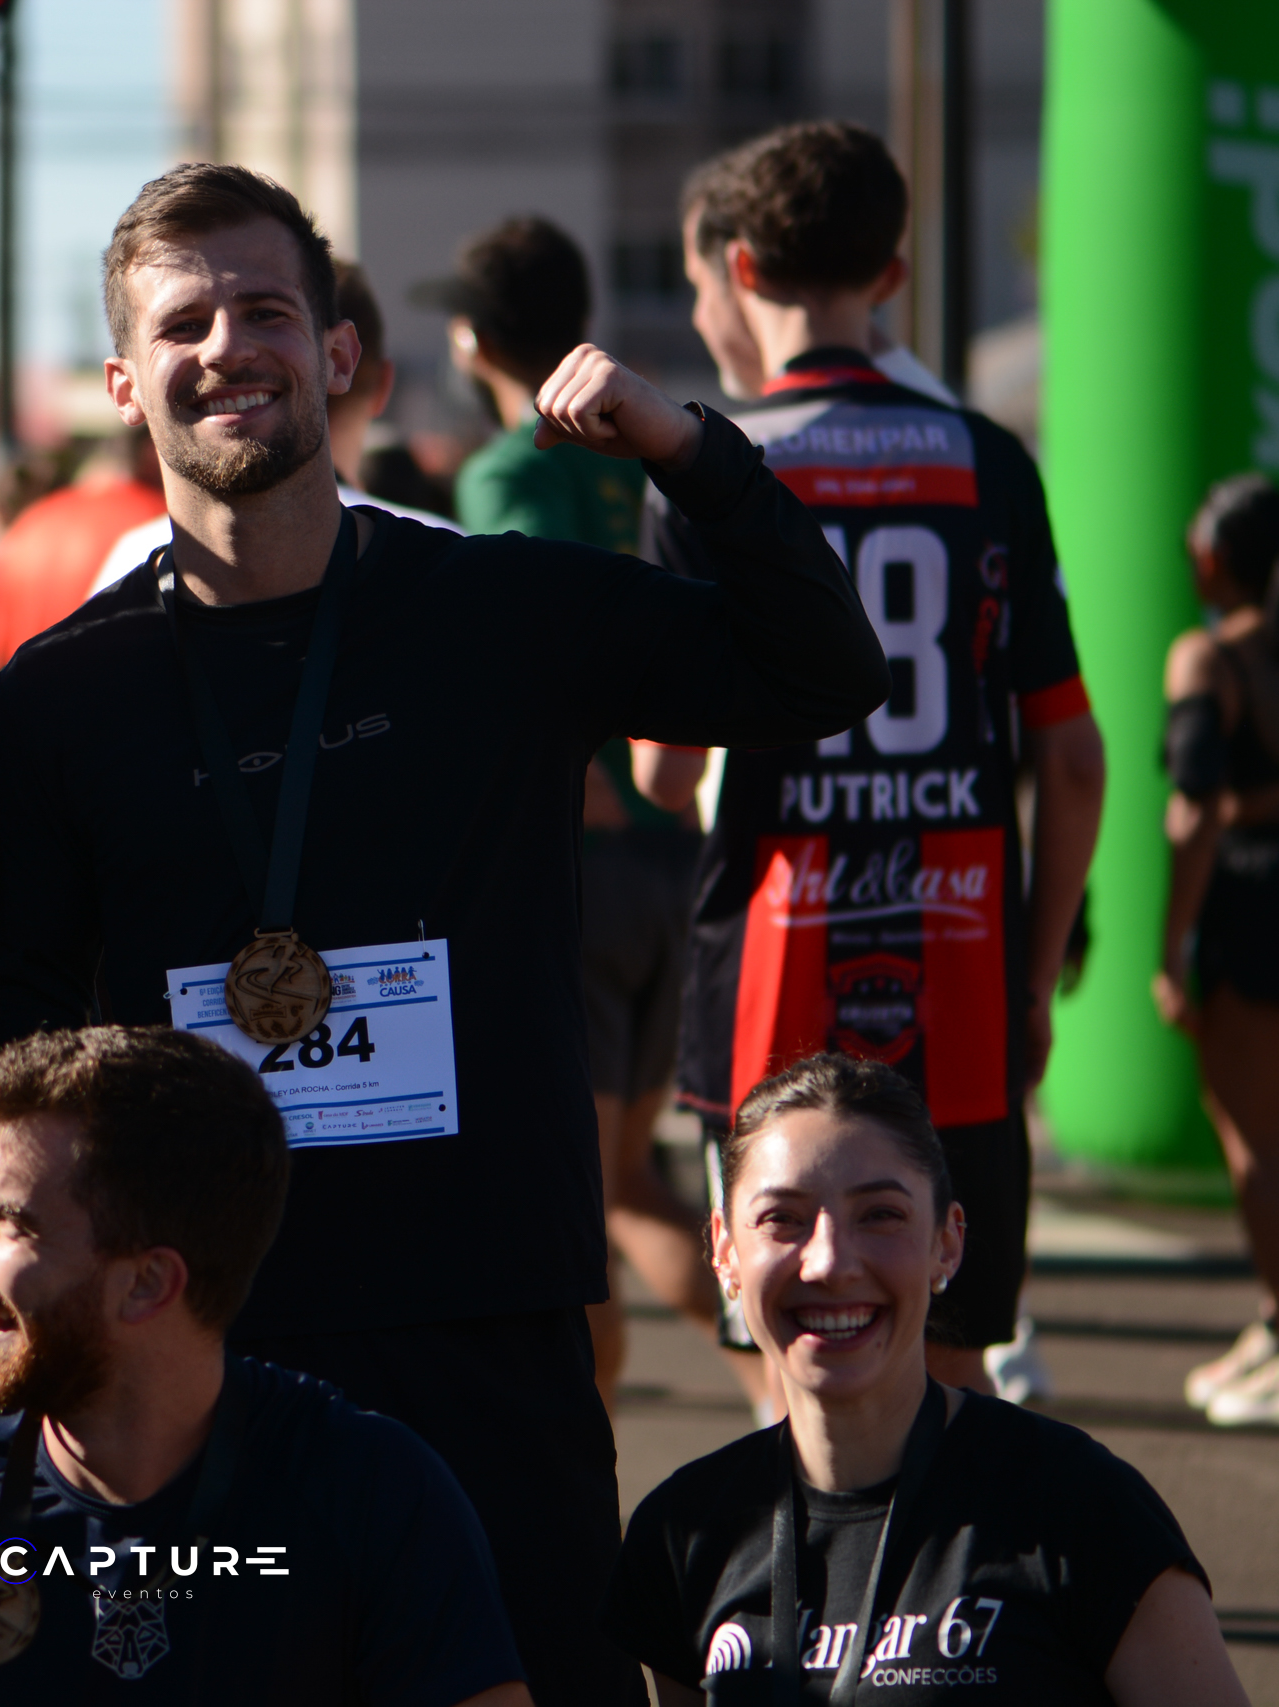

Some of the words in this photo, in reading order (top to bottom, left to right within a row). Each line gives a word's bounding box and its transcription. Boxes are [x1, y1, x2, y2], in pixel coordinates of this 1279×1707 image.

[779, 768, 982, 824] PUTRICK
[207, 984, 225, 995] EDIÇÃ
[379, 985, 417, 997] CAUSA
[289, 1087, 301, 1095] DA
[301, 1085, 329, 1093] ROCHA
[335, 1083, 360, 1091] Corrida
[288, 1113, 314, 1121] CRESOL
[937, 1595, 1004, 1660] 67
[872, 1664, 998, 1687] CONFECÇÕES
